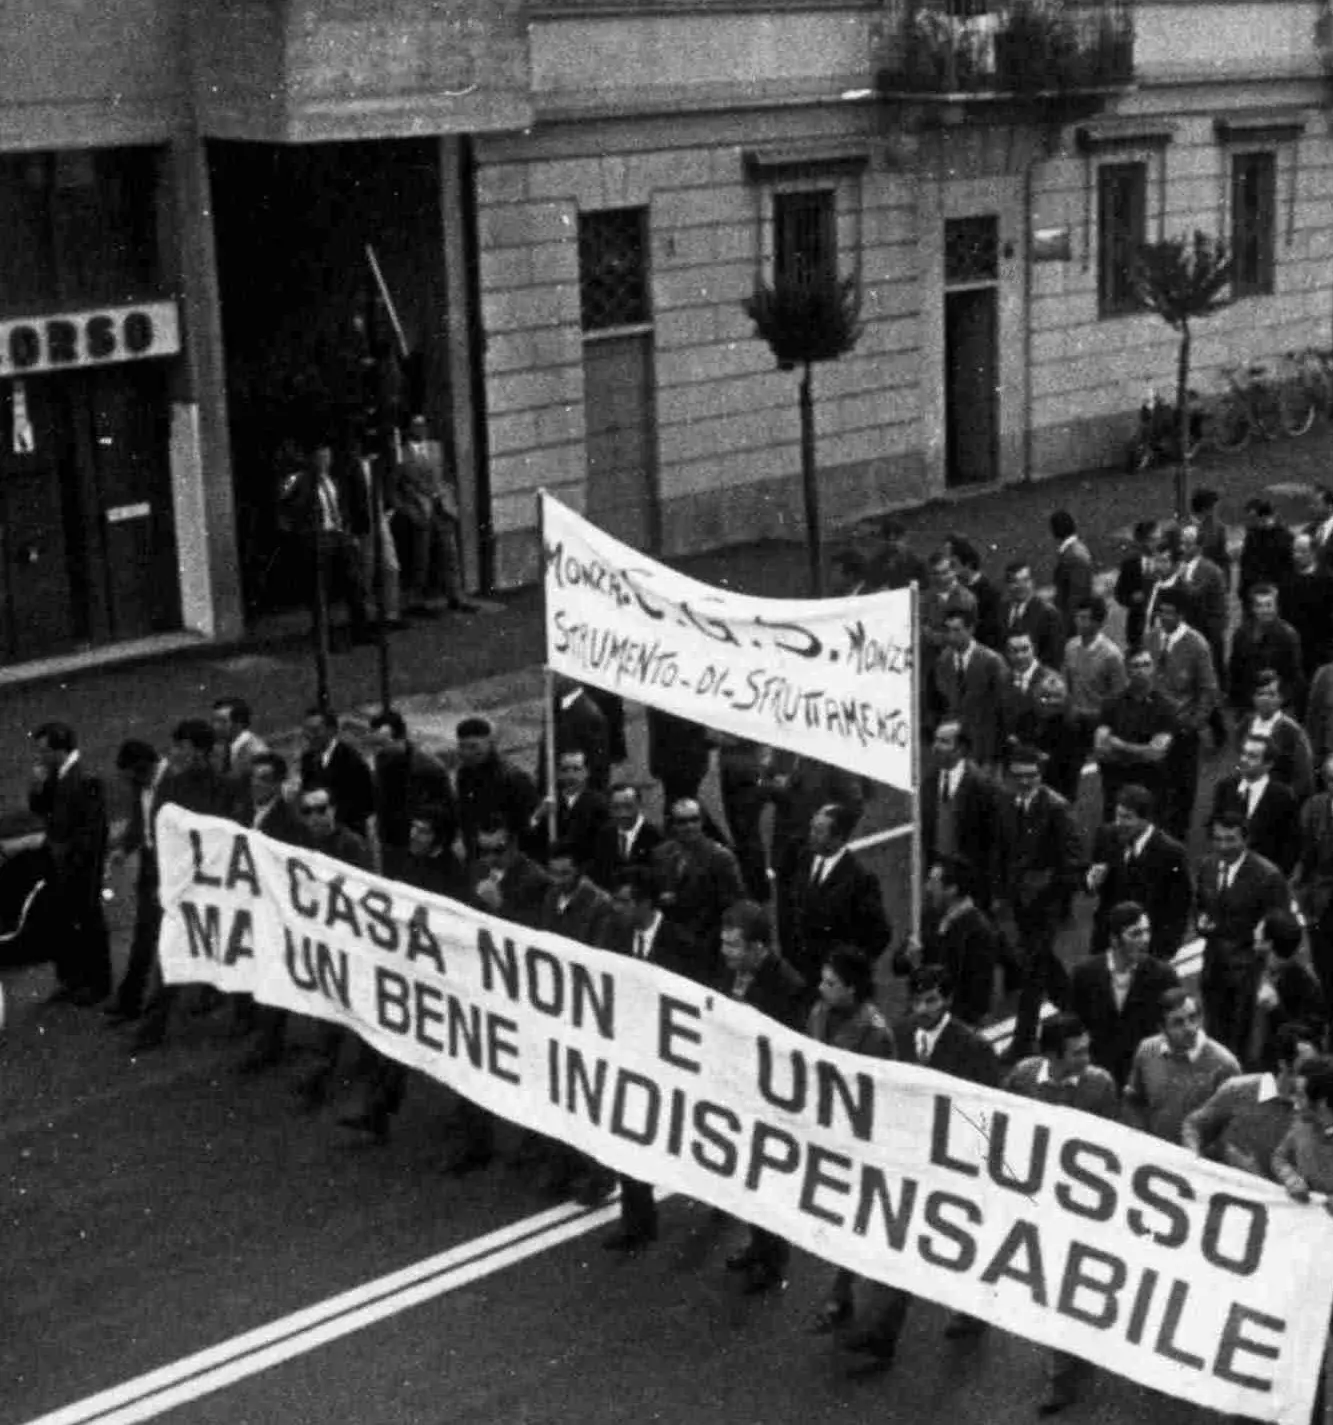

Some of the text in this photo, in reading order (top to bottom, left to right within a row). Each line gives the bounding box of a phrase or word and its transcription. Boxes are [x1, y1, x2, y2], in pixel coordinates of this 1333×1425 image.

[0, 311, 153, 369] ORSO
[181, 901, 1288, 1393] MA UN BENE INDISPENSABILE
[189, 829, 261, 897] LA
[286, 857, 447, 974] CASA
[477, 928, 615, 1040] NON
[757, 1035, 875, 1142] UN
[929, 1095, 1267, 1277] LUSSO
